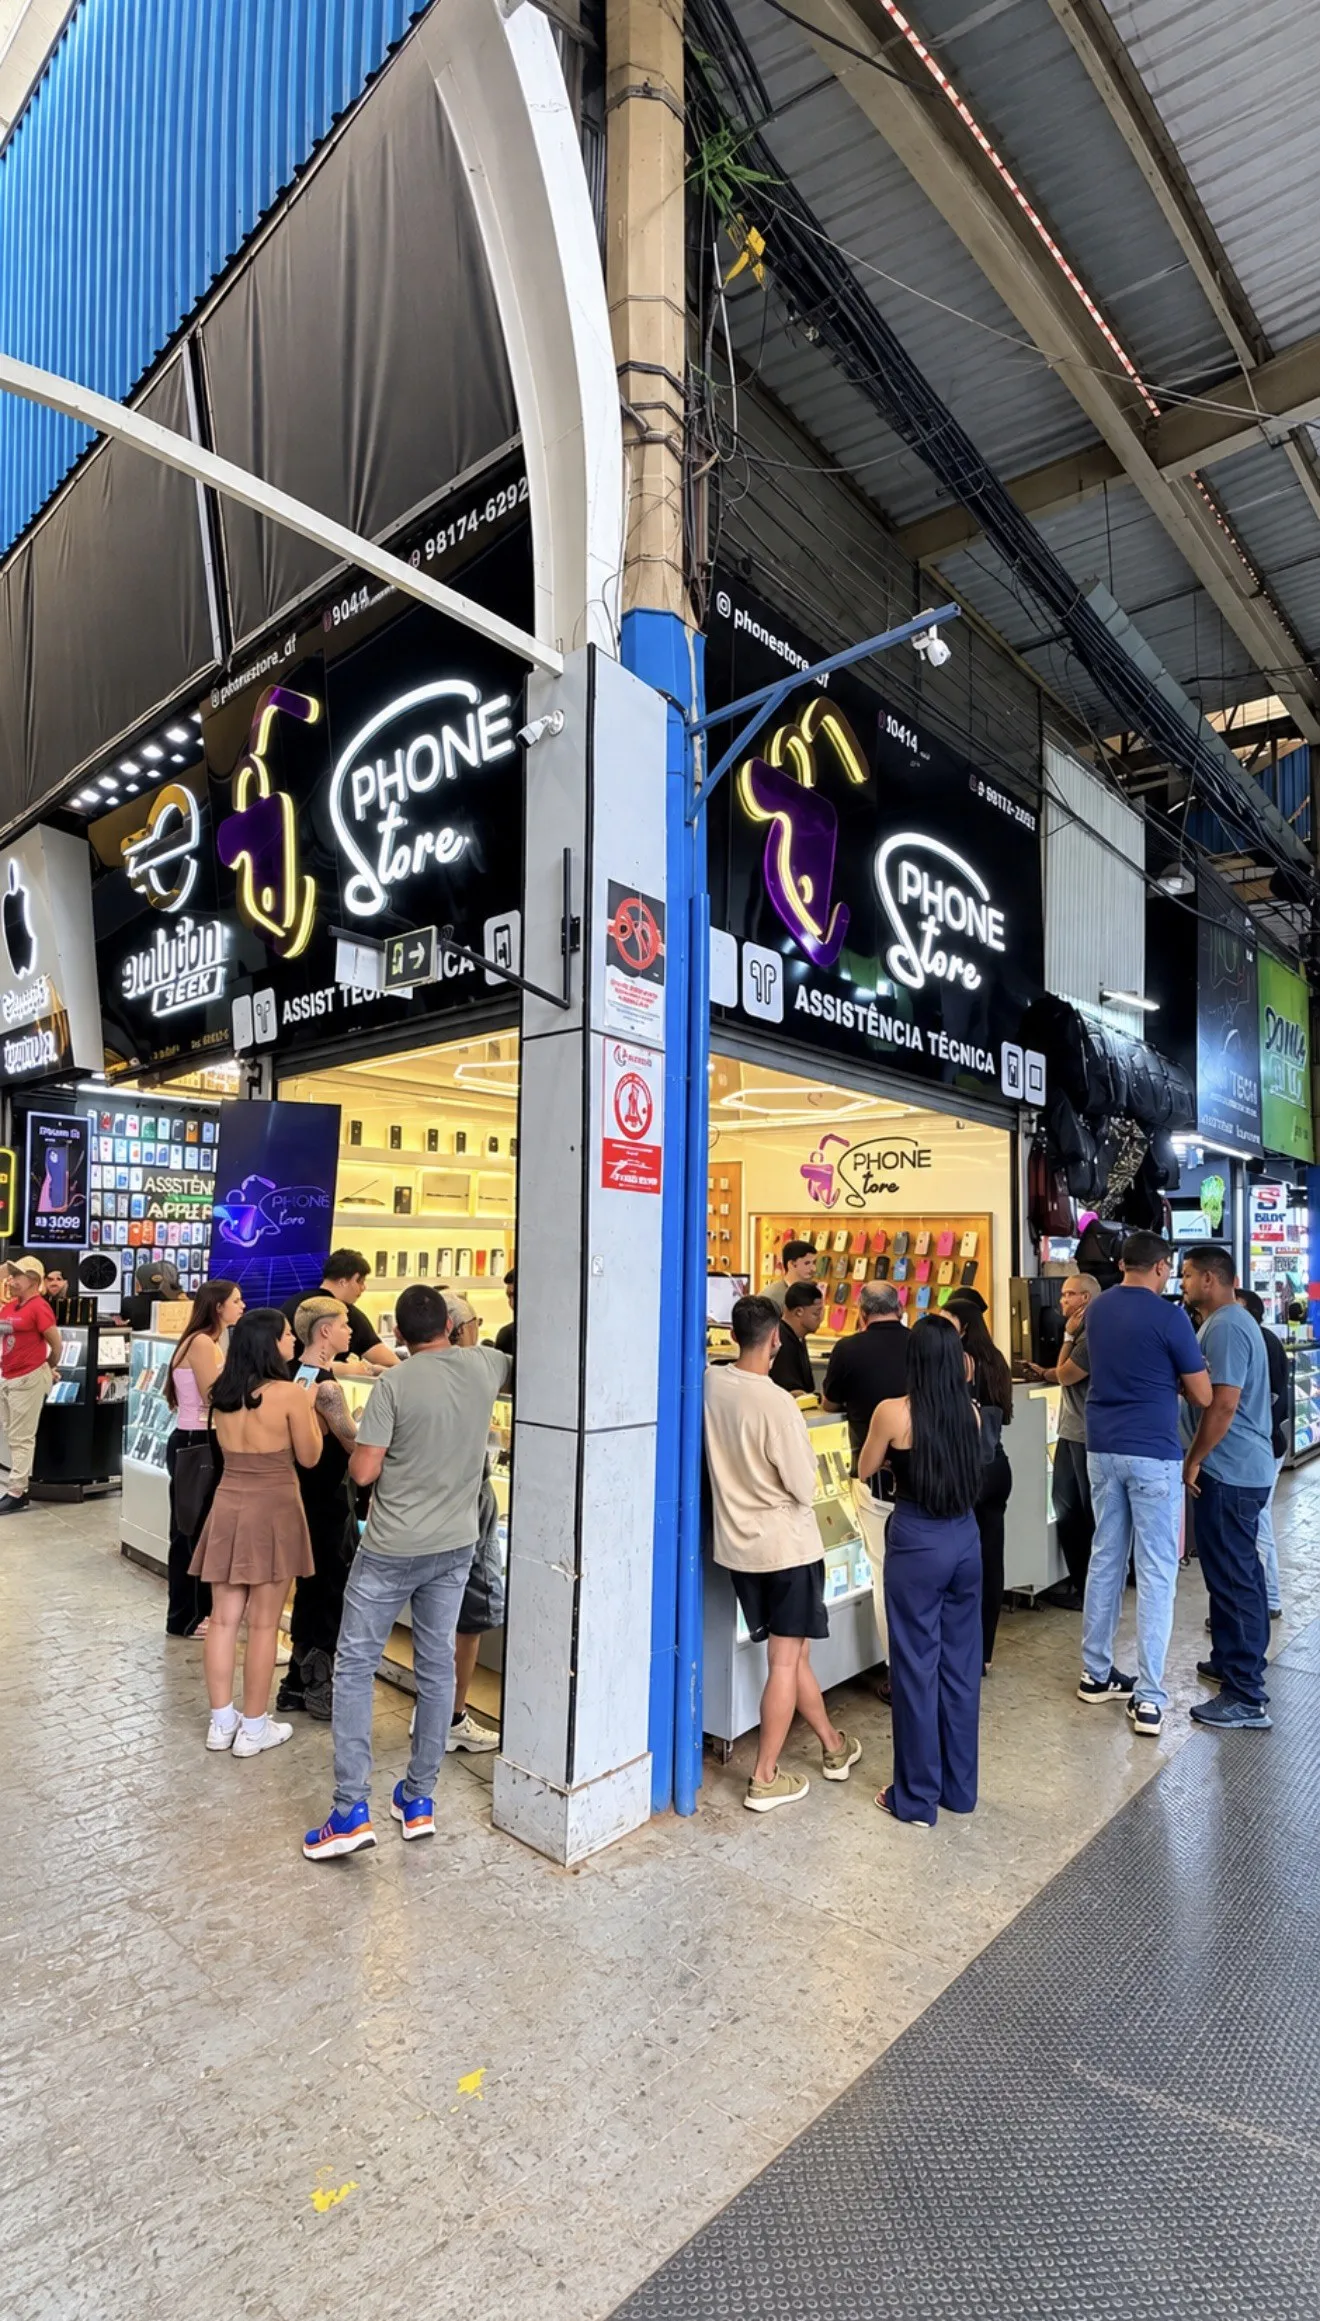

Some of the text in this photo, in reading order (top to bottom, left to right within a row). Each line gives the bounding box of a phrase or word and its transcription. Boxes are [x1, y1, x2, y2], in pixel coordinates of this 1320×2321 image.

[352, 693, 516, 822] PHONE
[898, 859, 1006, 952] PHONE
[282, 987, 336, 1025] ASSIST
[794, 984, 996, 1075] ASSISTÊNCIA TÉCNICA
[853, 1149, 932, 1171] PHONE
[271, 1194, 331, 1209] PHONE
